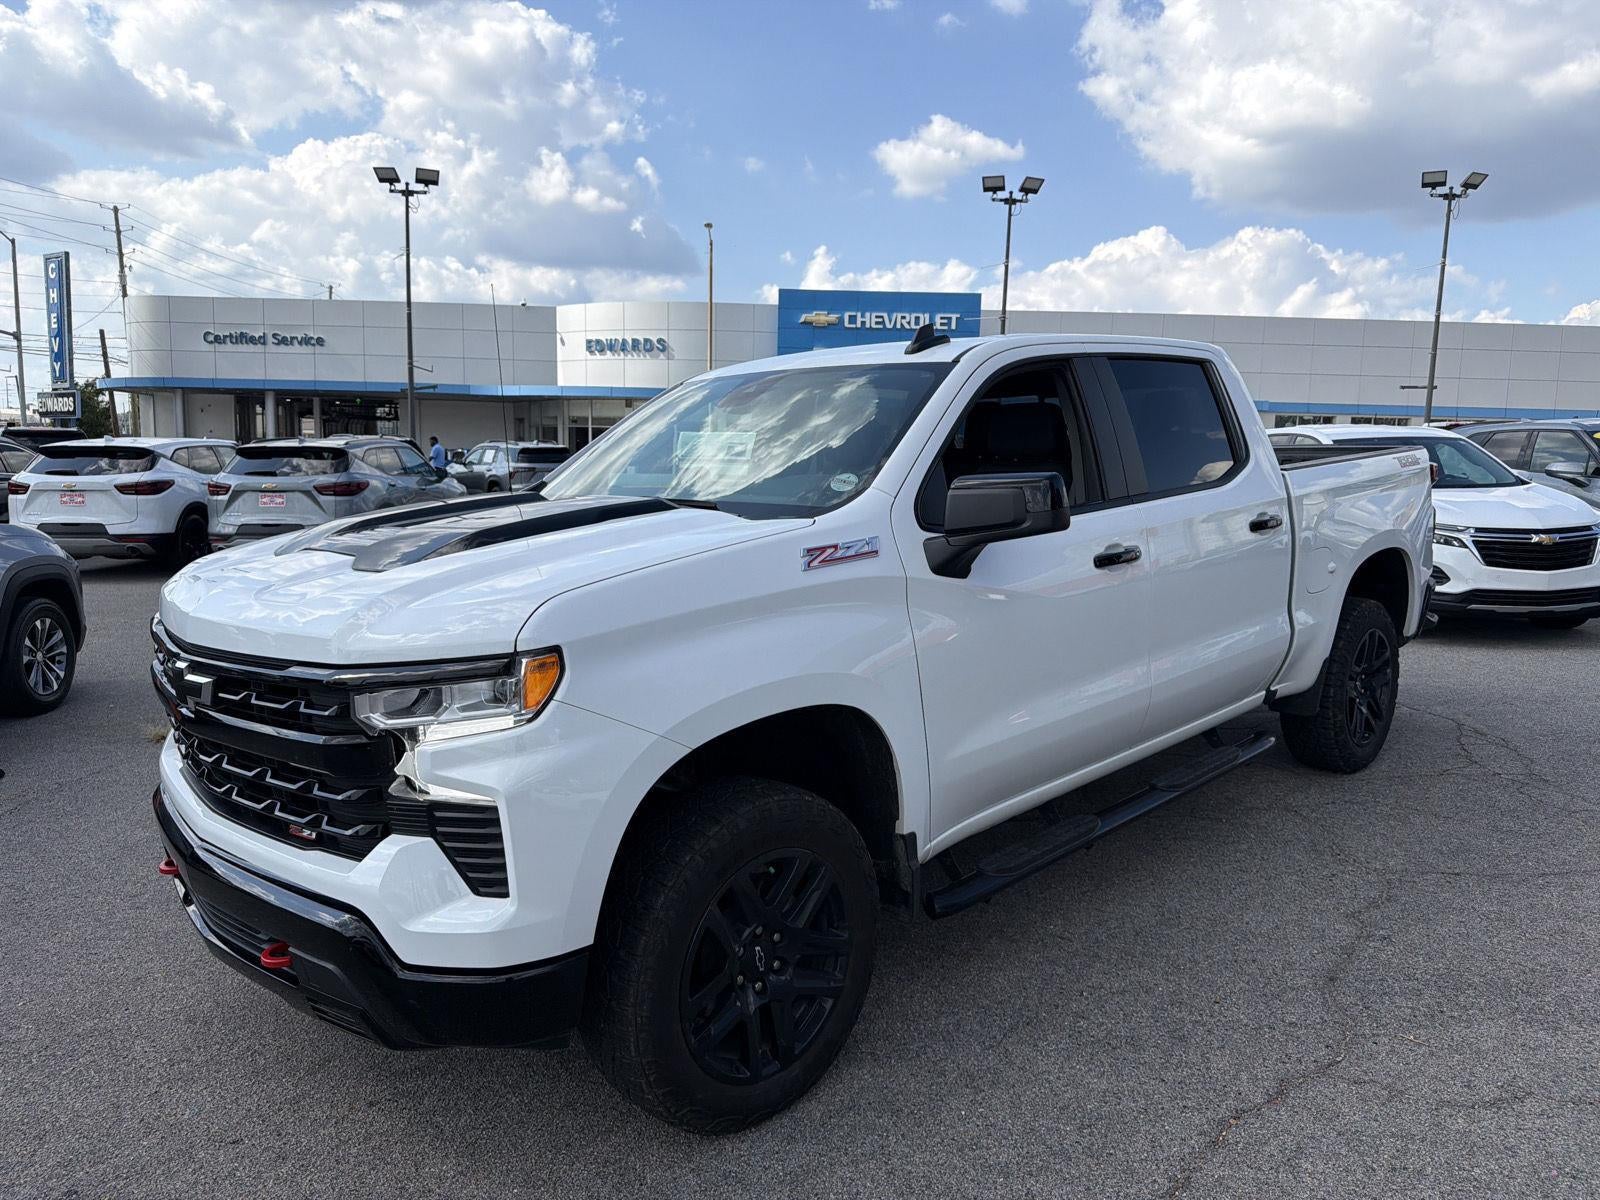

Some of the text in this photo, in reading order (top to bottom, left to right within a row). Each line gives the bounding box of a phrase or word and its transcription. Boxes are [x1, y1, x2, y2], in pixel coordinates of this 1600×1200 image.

[48, 263, 62, 378] CHEVY
[843, 311, 961, 330] CHEVROLET
[203, 331, 326, 347] Certified Service
[585, 337, 668, 353] EDWARDS
[38, 396, 74, 412] EDWARDS
[800, 536, 879, 572] Z71
